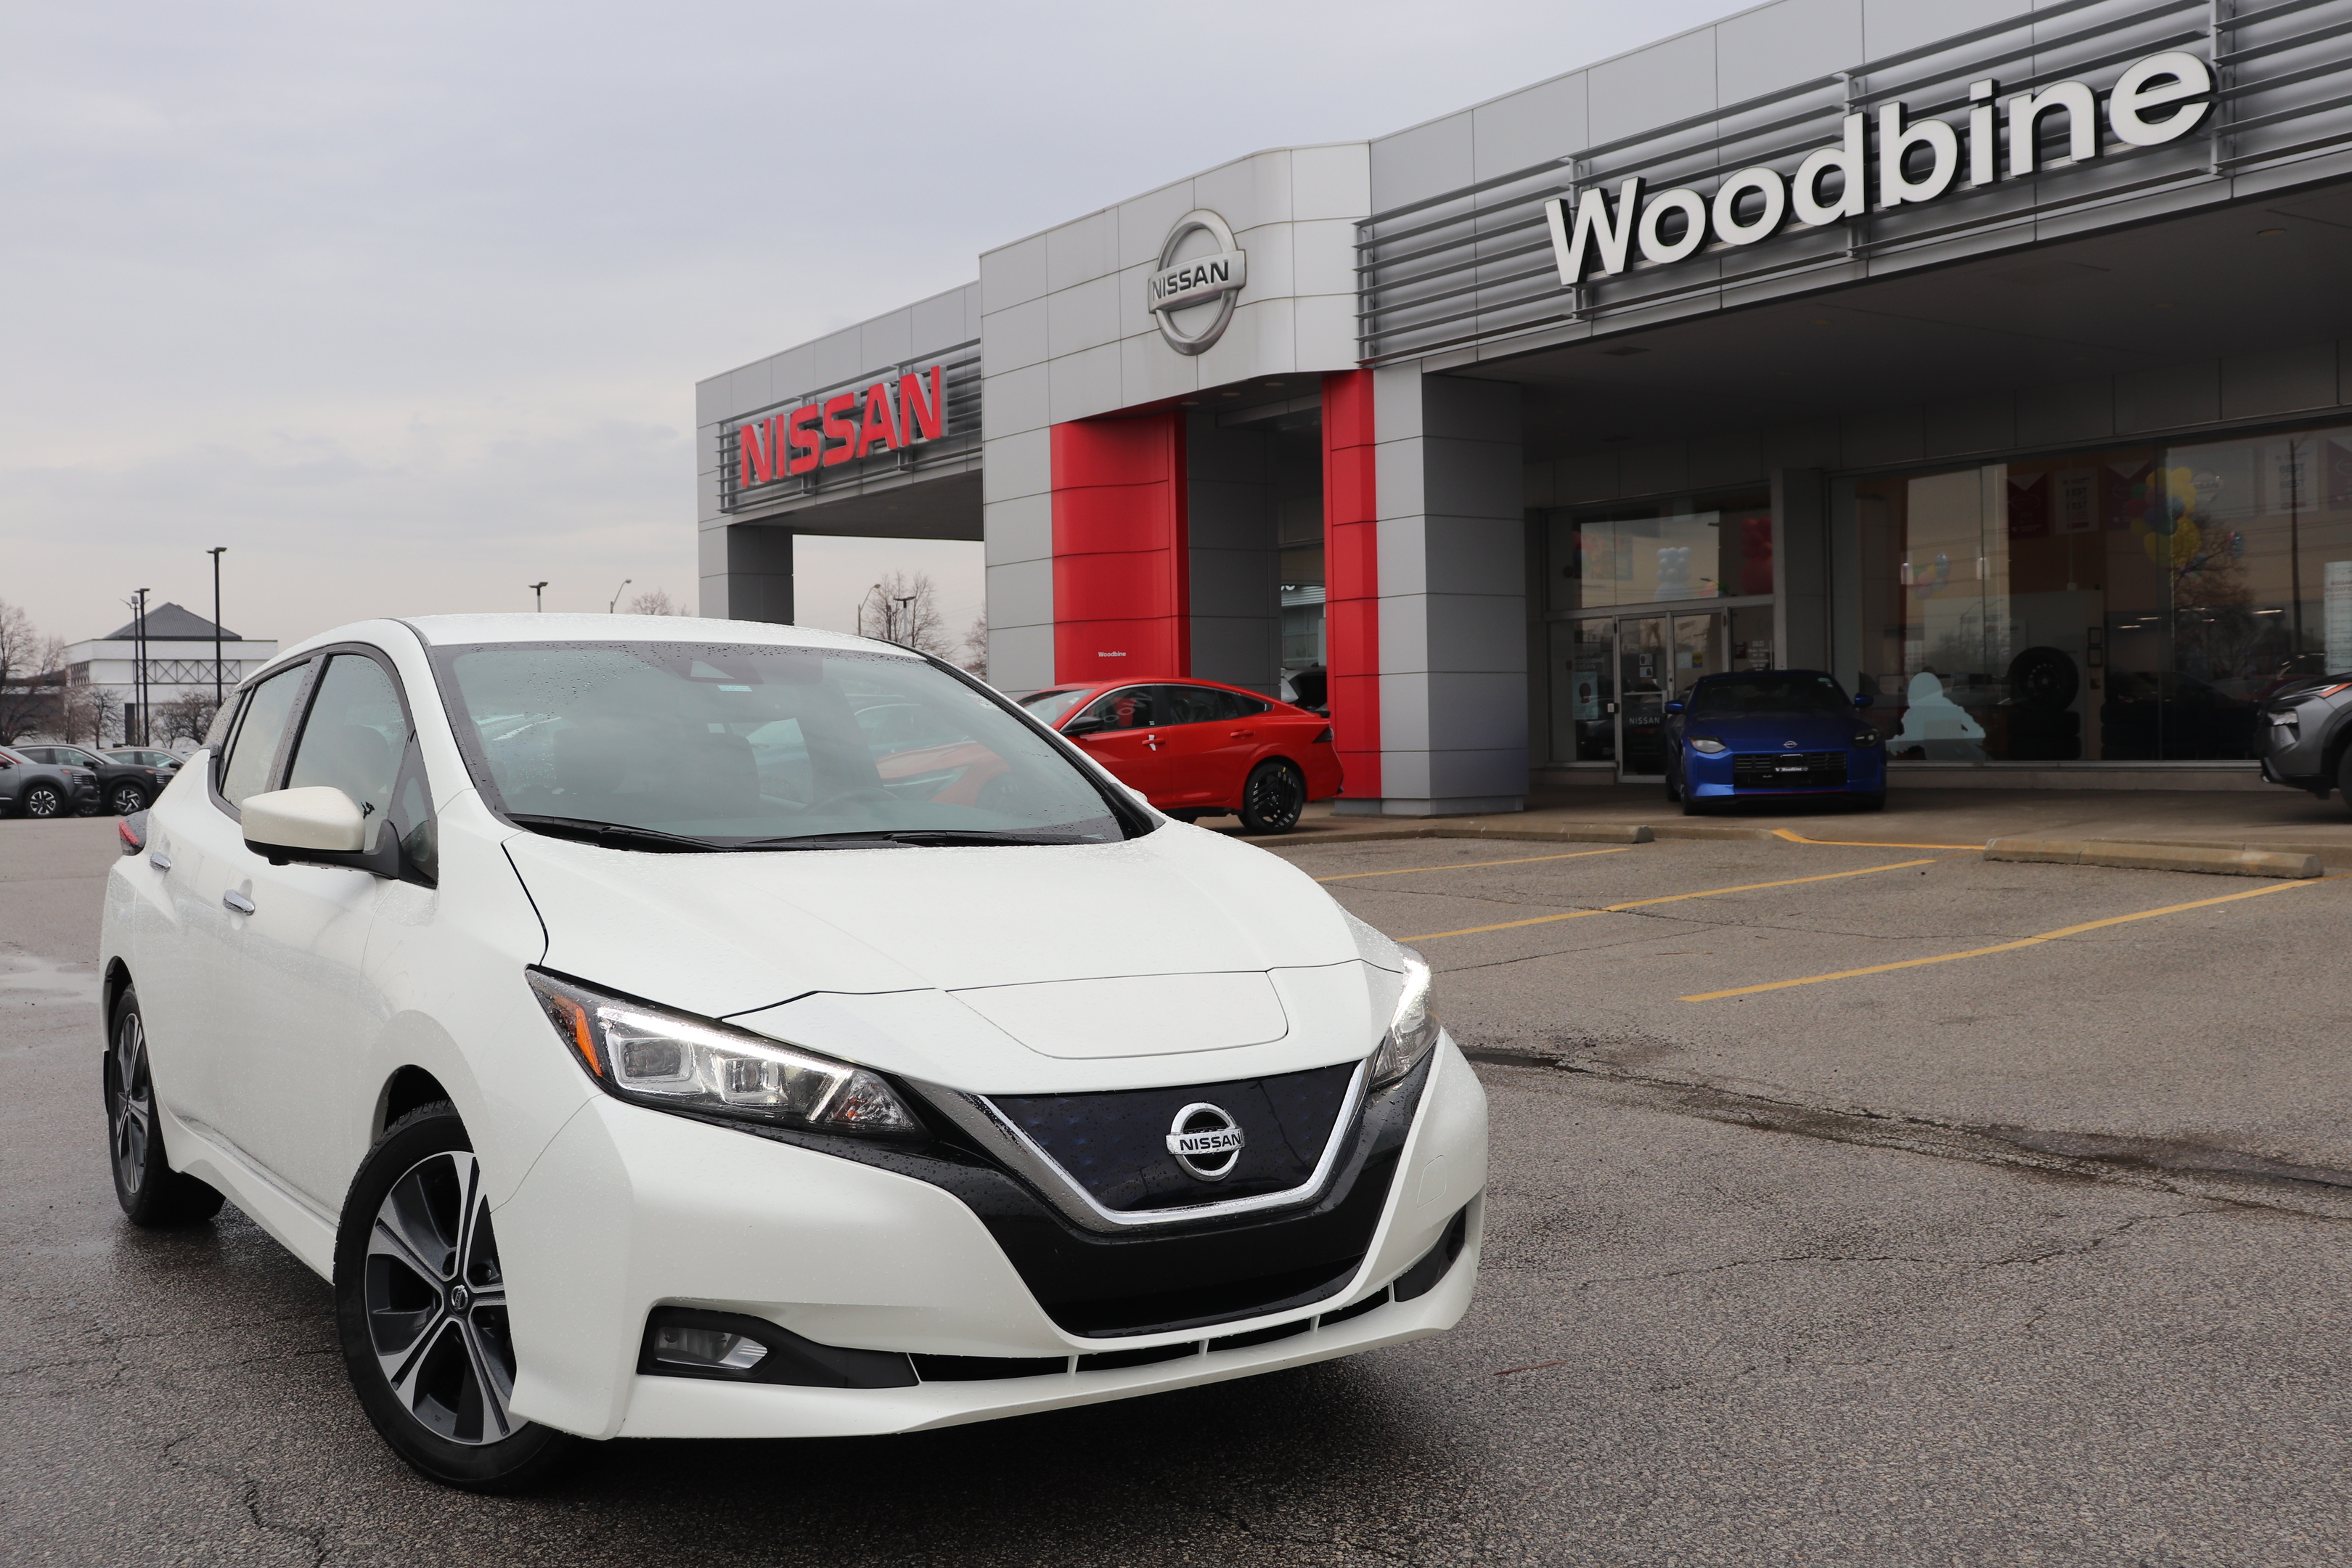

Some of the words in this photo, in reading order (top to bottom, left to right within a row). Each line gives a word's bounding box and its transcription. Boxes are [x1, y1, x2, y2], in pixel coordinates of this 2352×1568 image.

[1545, 50, 2213, 287] Woodbine
[1151, 258, 1228, 302] NISSAN
[739, 364, 949, 489] NISSAN
[1179, 1132, 1242, 1151] NISSAN
